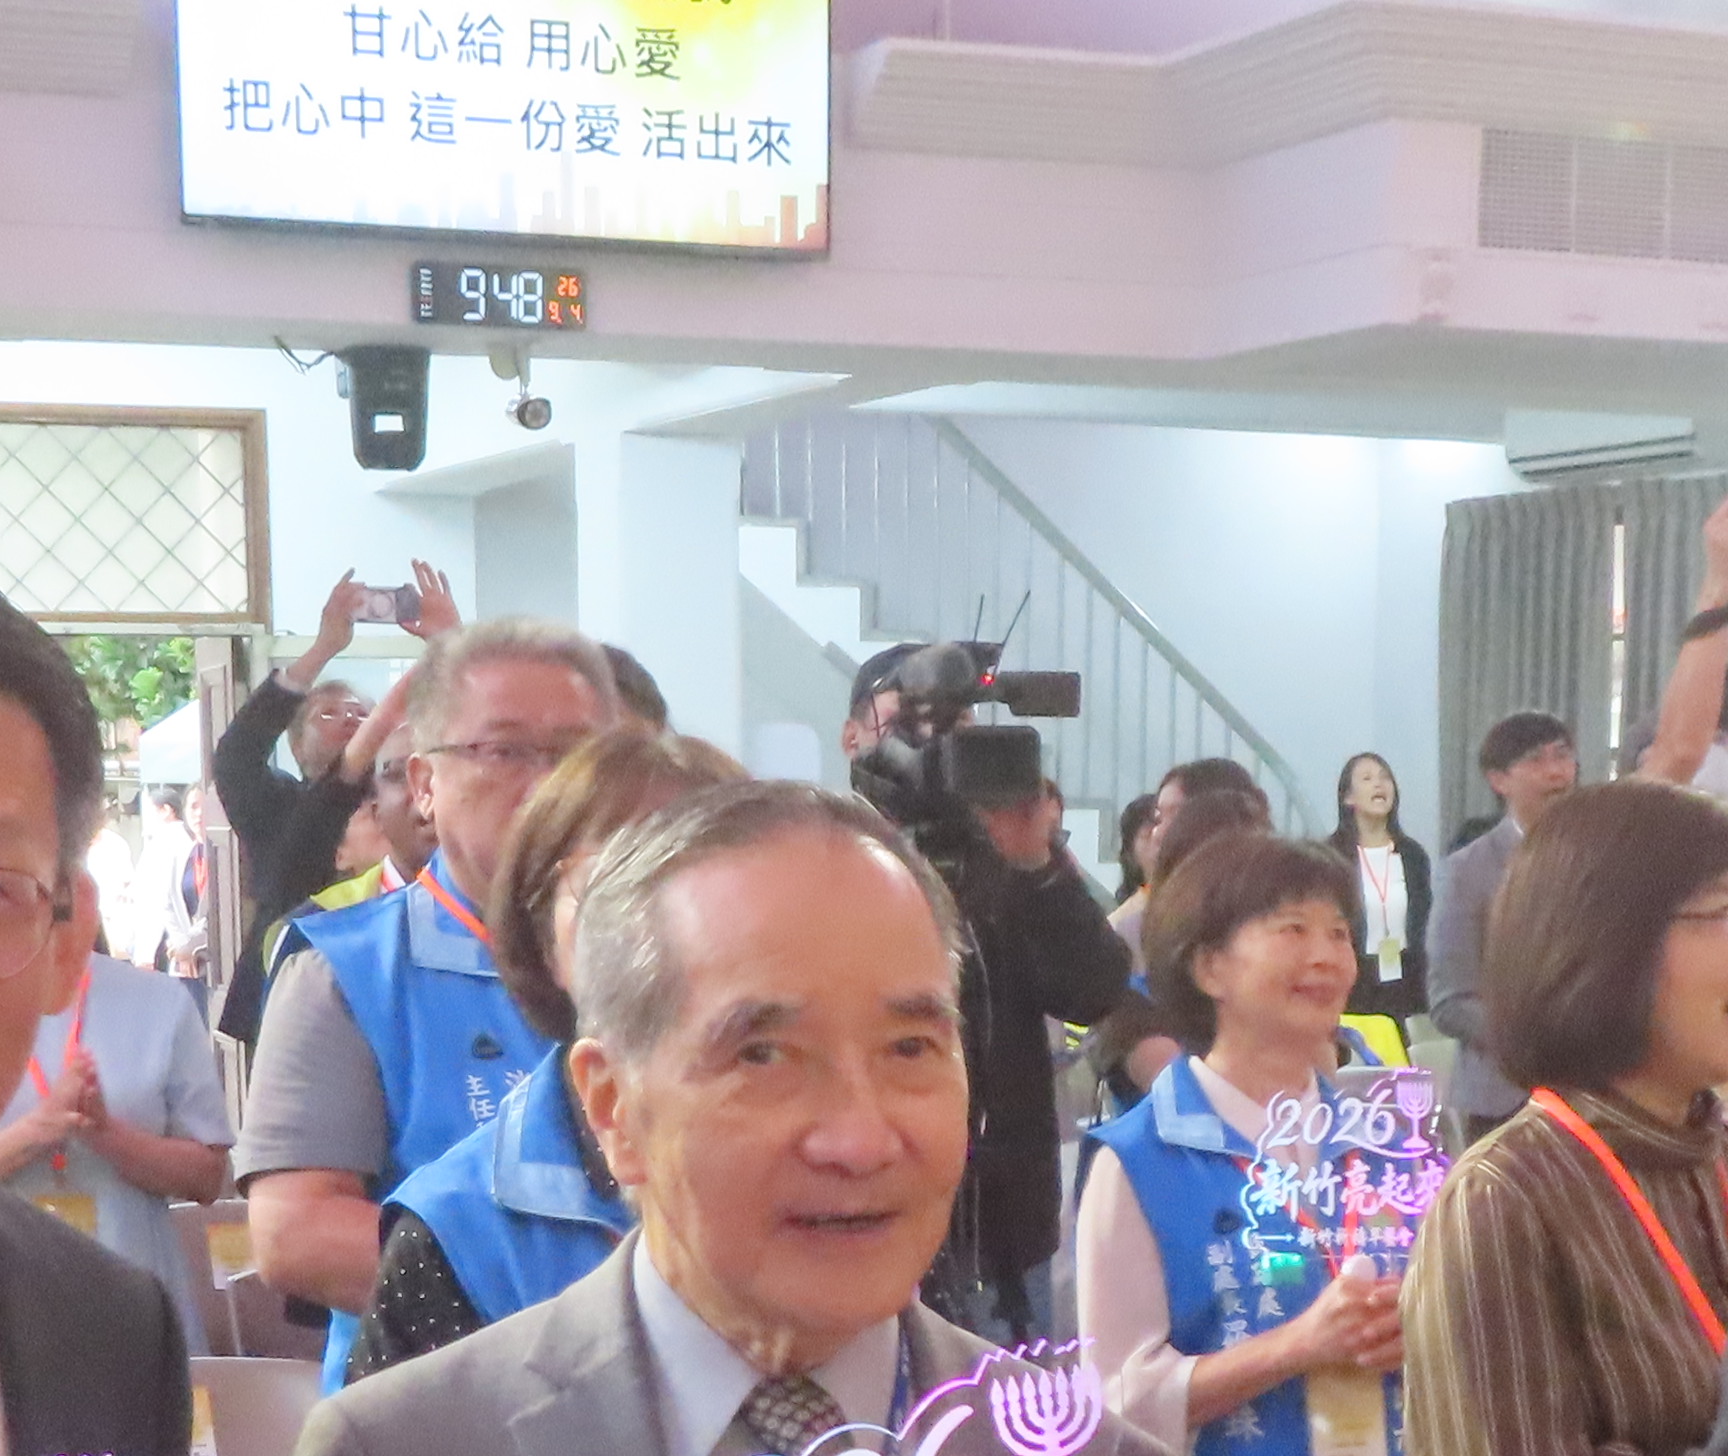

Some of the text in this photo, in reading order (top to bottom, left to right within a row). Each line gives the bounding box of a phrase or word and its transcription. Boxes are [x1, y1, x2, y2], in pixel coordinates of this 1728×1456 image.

[344, 3, 681, 81] 甘心給 用心愛
[222, 77, 793, 167] 把心中 這一份愛 活出來
[1268, 1088, 1396, 1150] 2026
